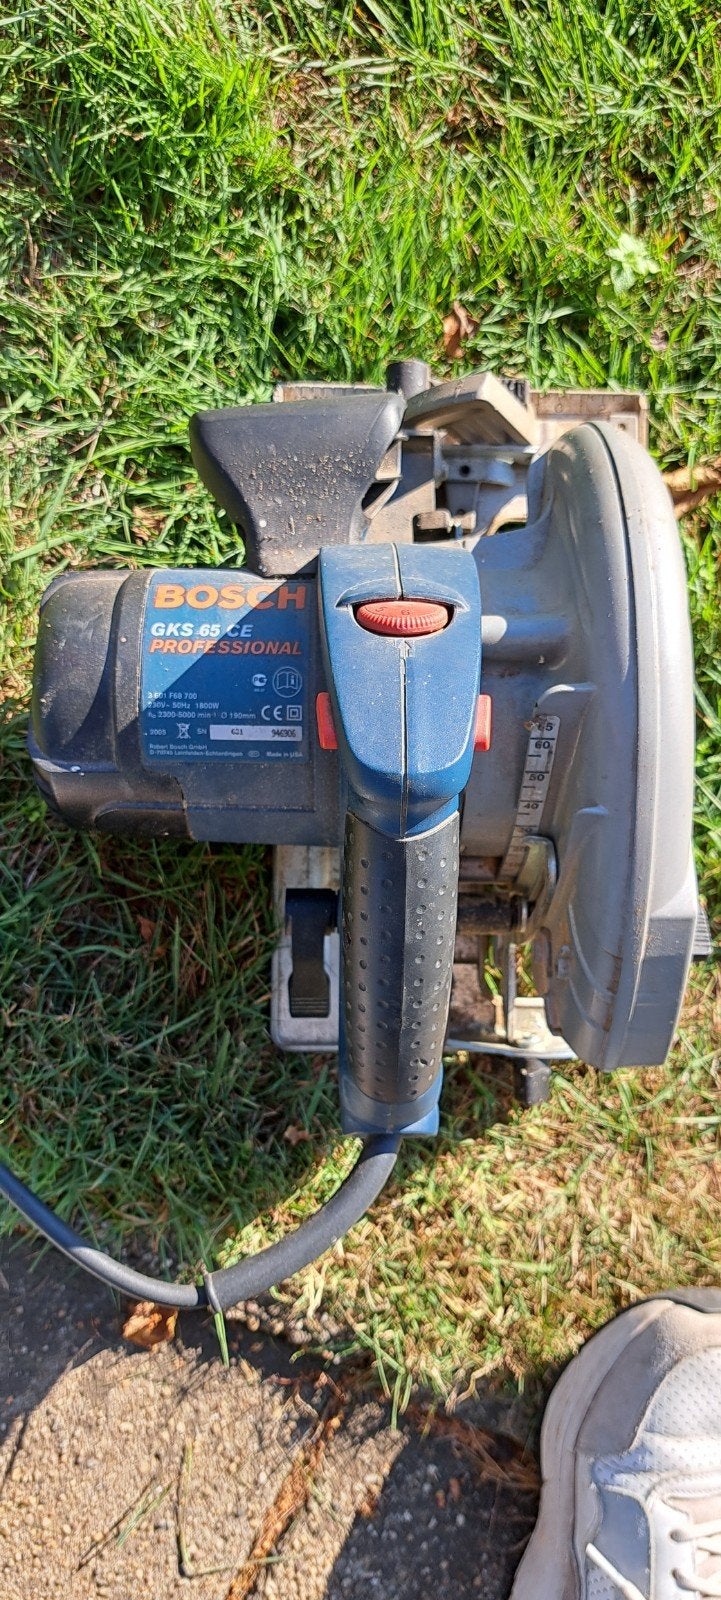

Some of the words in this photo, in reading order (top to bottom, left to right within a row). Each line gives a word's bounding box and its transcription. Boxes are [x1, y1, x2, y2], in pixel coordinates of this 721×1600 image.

[154, 583, 306, 609] BOSCH
[150, 622, 194, 637] GKS
[199, 623, 222, 637] 65
[227, 624, 253, 638] CE
[149, 639, 301, 655] PROFESSIONAL
[229, 711, 256, 719] 190mm
[261, 705, 283, 721] CE
[196, 727, 208, 735] SN
[534, 740, 551, 750] 60
[528, 773, 546, 782] 50
